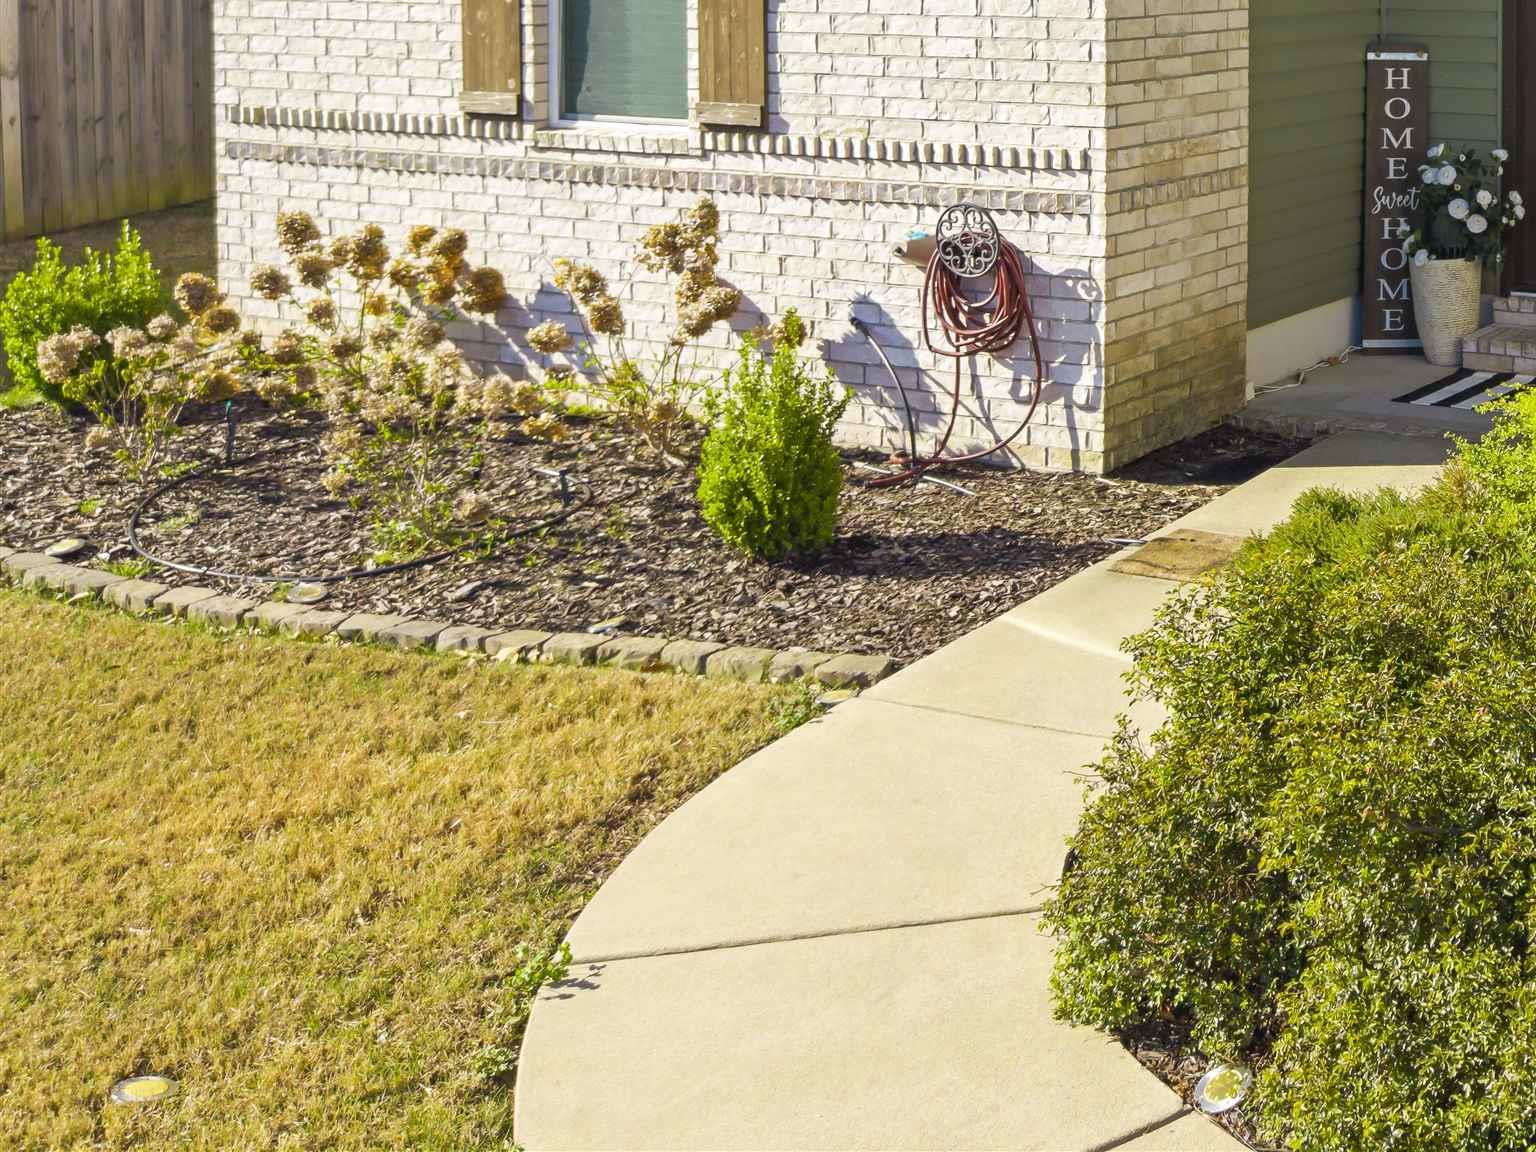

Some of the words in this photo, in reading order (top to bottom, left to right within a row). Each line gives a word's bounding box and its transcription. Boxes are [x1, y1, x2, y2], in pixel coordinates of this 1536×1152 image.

[1380, 67, 1414, 179] HOME
[1371, 185, 1420, 215] Sweet
[1377, 217, 1409, 331] HOME
